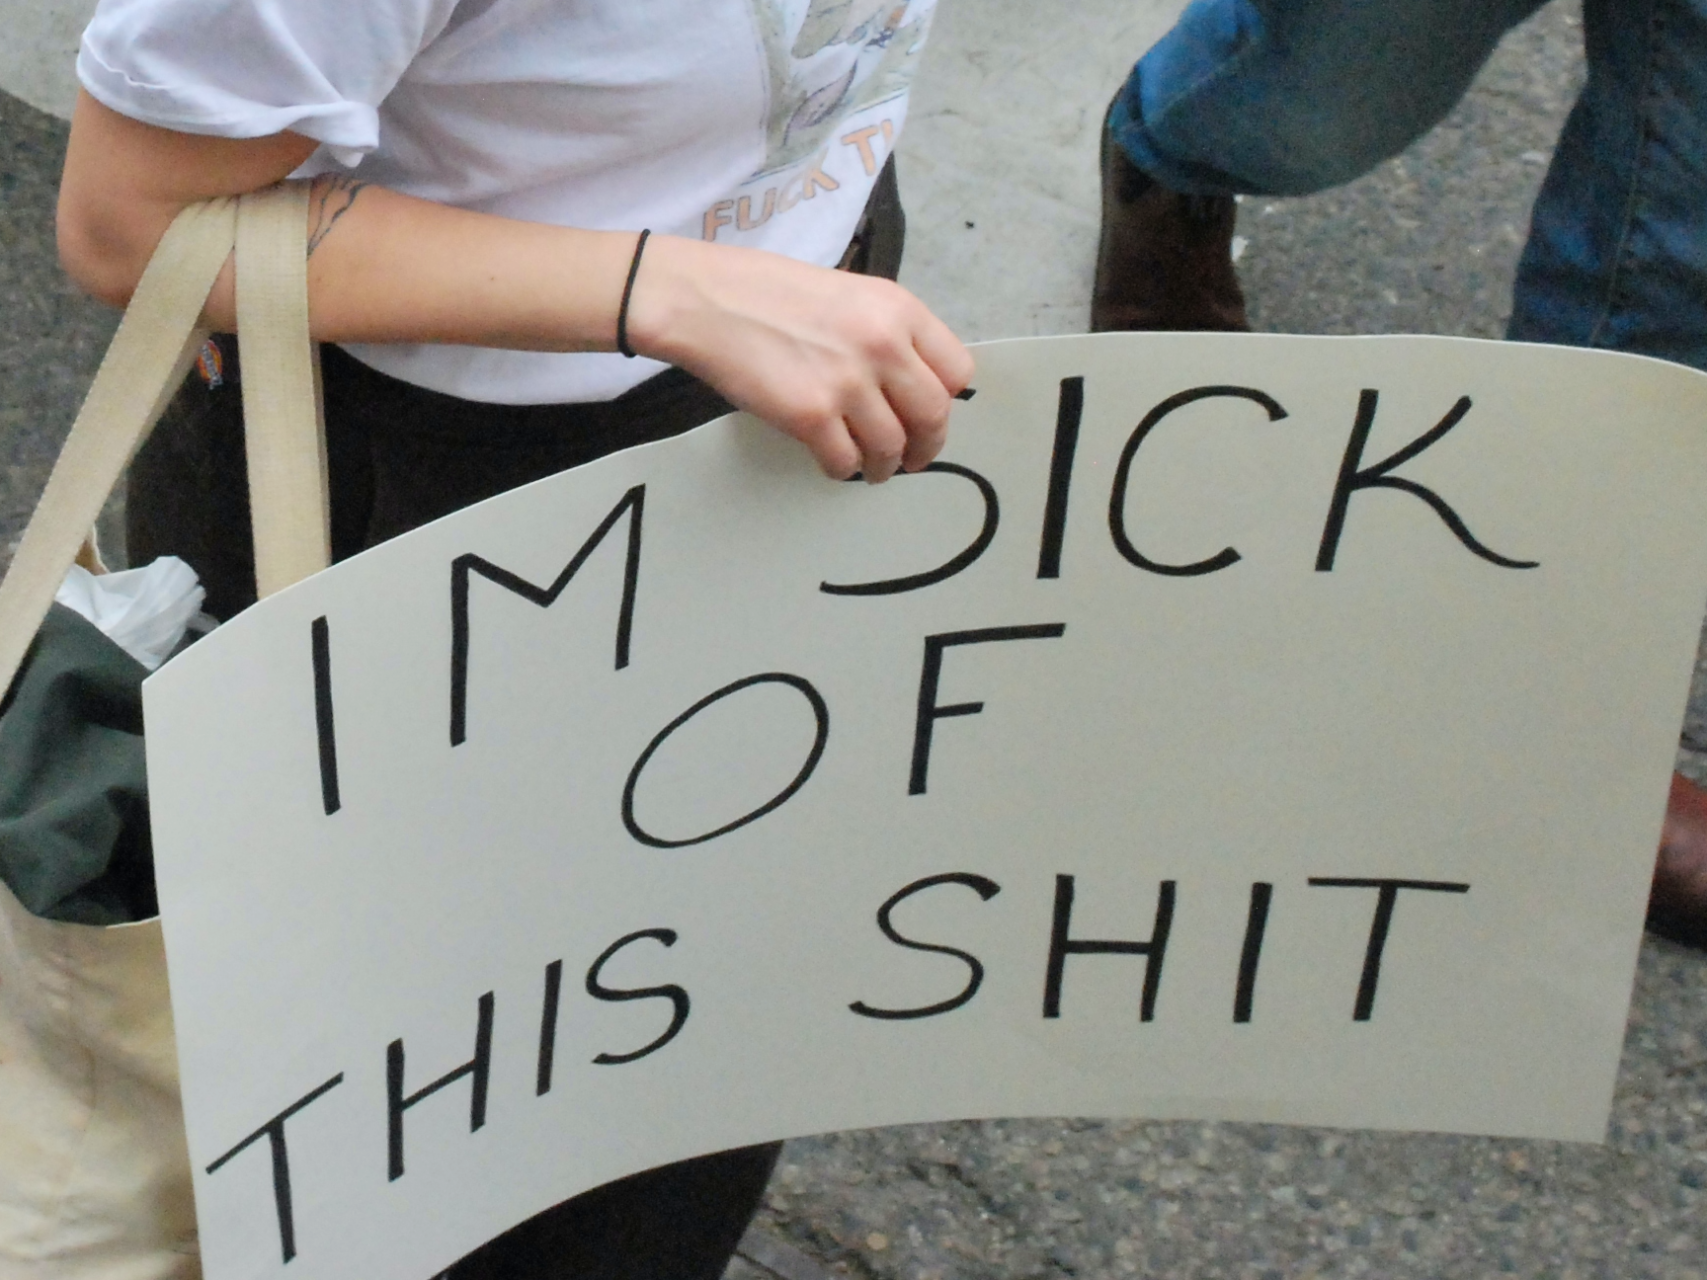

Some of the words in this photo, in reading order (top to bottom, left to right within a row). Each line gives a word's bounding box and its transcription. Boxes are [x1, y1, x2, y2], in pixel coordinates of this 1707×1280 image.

[703, 146, 840, 243] FUCK
[819, 376, 1540, 596] SICK
[621, 623, 1067, 849] OF
[205, 928, 690, 1264] THIS
[848, 872, 1471, 1024] SHIT
